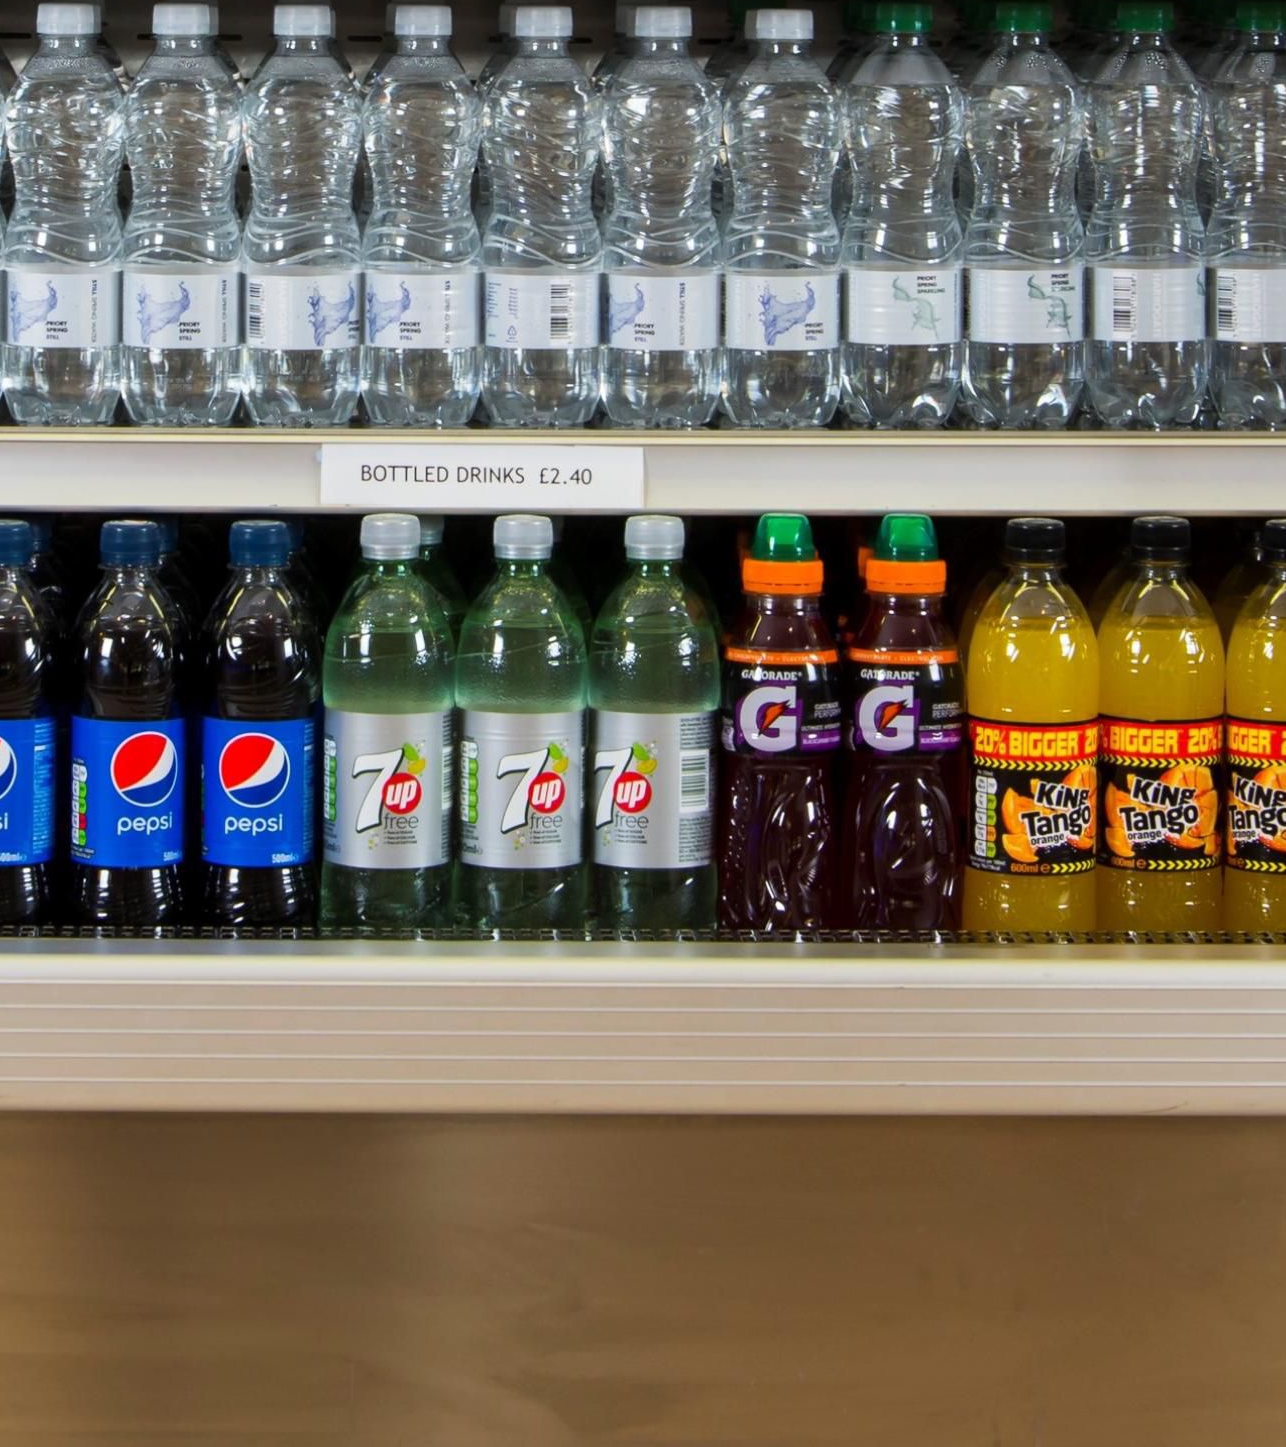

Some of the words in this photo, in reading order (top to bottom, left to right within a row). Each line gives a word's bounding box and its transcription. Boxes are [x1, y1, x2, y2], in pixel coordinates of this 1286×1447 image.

[361, 465, 449, 483] BOTTLED
[456, 466, 525, 485] DRINKS
[539, 467, 593, 486] £2.40
[740, 685, 797, 752] G
[859, 685, 914, 752] G
[975, 726, 1007, 755] 20%
[1009, 730, 1079, 757] BIGGER
[1109, 727, 1180, 754] BIGGER
[1187, 726, 1219, 754] 20%
[117, 812, 174, 835] pepsi
[223, 814, 284, 836] pepsi
[383, 812, 420, 832] free
[529, 811, 563, 830] free
[1019, 804, 1093, 837] Tango
[1119, 803, 1199, 835] Tango
[1127, 829, 1163, 842] orange
[1010, 862, 1039, 873] 600ml
